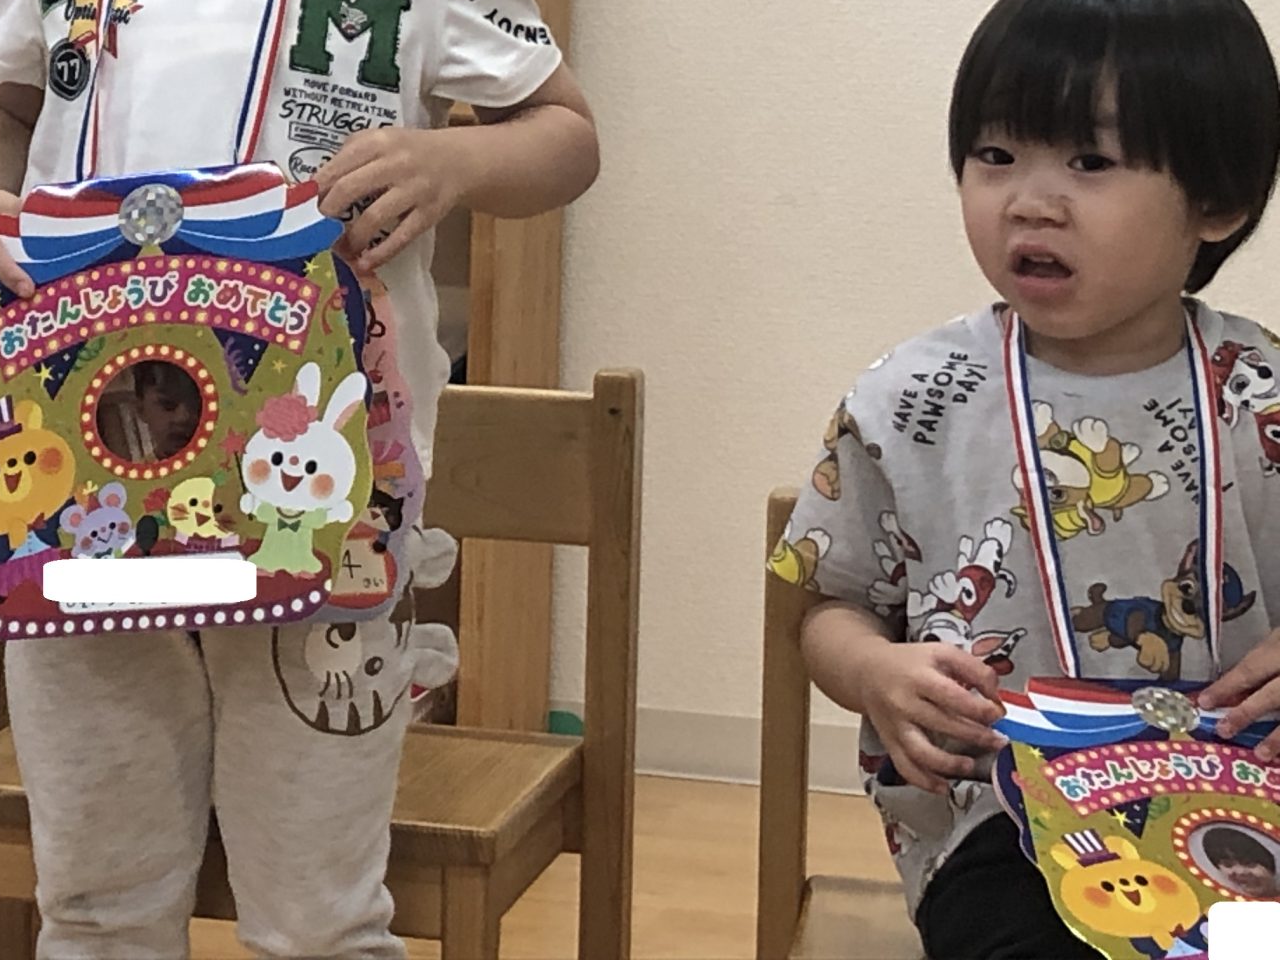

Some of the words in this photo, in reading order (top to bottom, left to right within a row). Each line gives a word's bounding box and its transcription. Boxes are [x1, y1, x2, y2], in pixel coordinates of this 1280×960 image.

[483, 8, 552, 46] ENJOY
[56, 57, 81, 83] 77
[283, 87, 328, 103] WITHOUT
[330, 97, 397, 120] RETREATING
[303, 78, 330, 92] MOVE
[330, 84, 377, 103] FORWARD
[278, 99, 393, 133] STRUGGL
[0, 272, 179, 357] おたんじょうび
[186, 276, 308, 334] おめでとう
[892, 389, 918, 432] HAVE
[911, 373, 929, 383] A
[912, 352, 968, 445] PAWSOME
[1157, 440, 1175, 453] A
[342, 549, 362, 579] 4
[1056, 754, 1224, 801] おたんじょうび
